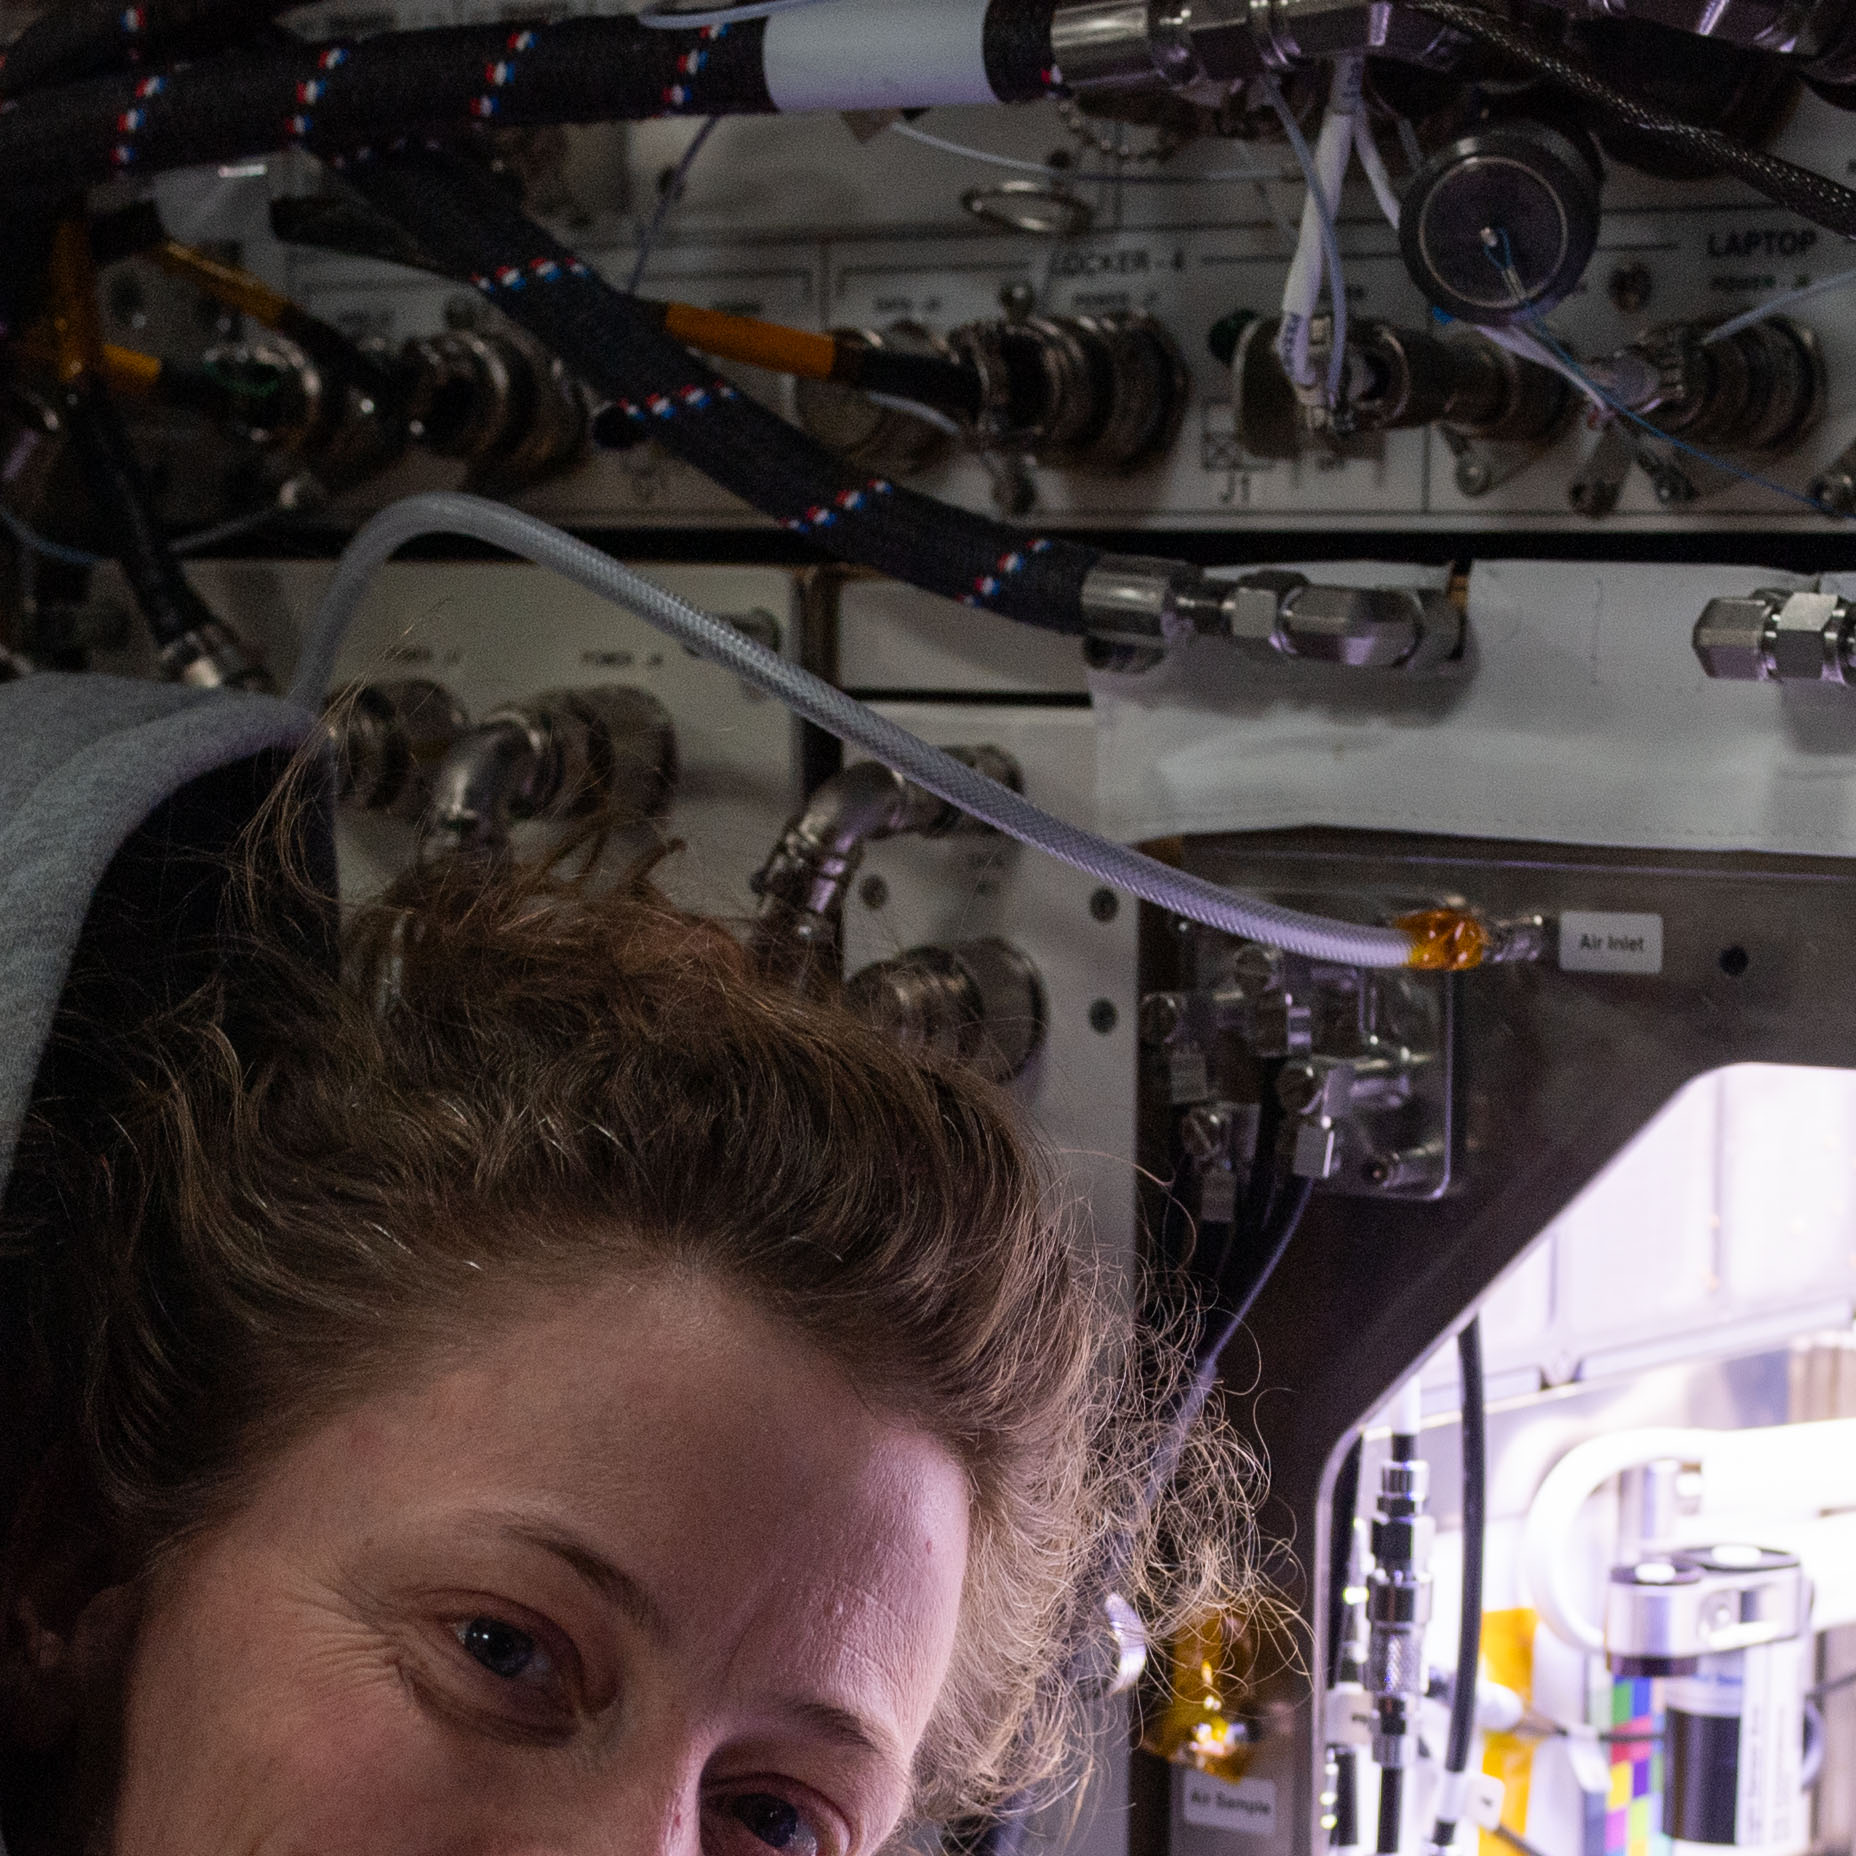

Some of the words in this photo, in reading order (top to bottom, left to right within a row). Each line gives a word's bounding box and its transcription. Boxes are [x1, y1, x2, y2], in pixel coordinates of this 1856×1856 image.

[1706, 226, 1818, 259] LAPTOP
[1579, 931, 1604, 951] Air
[1607, 933, 1646, 954] Inlet
